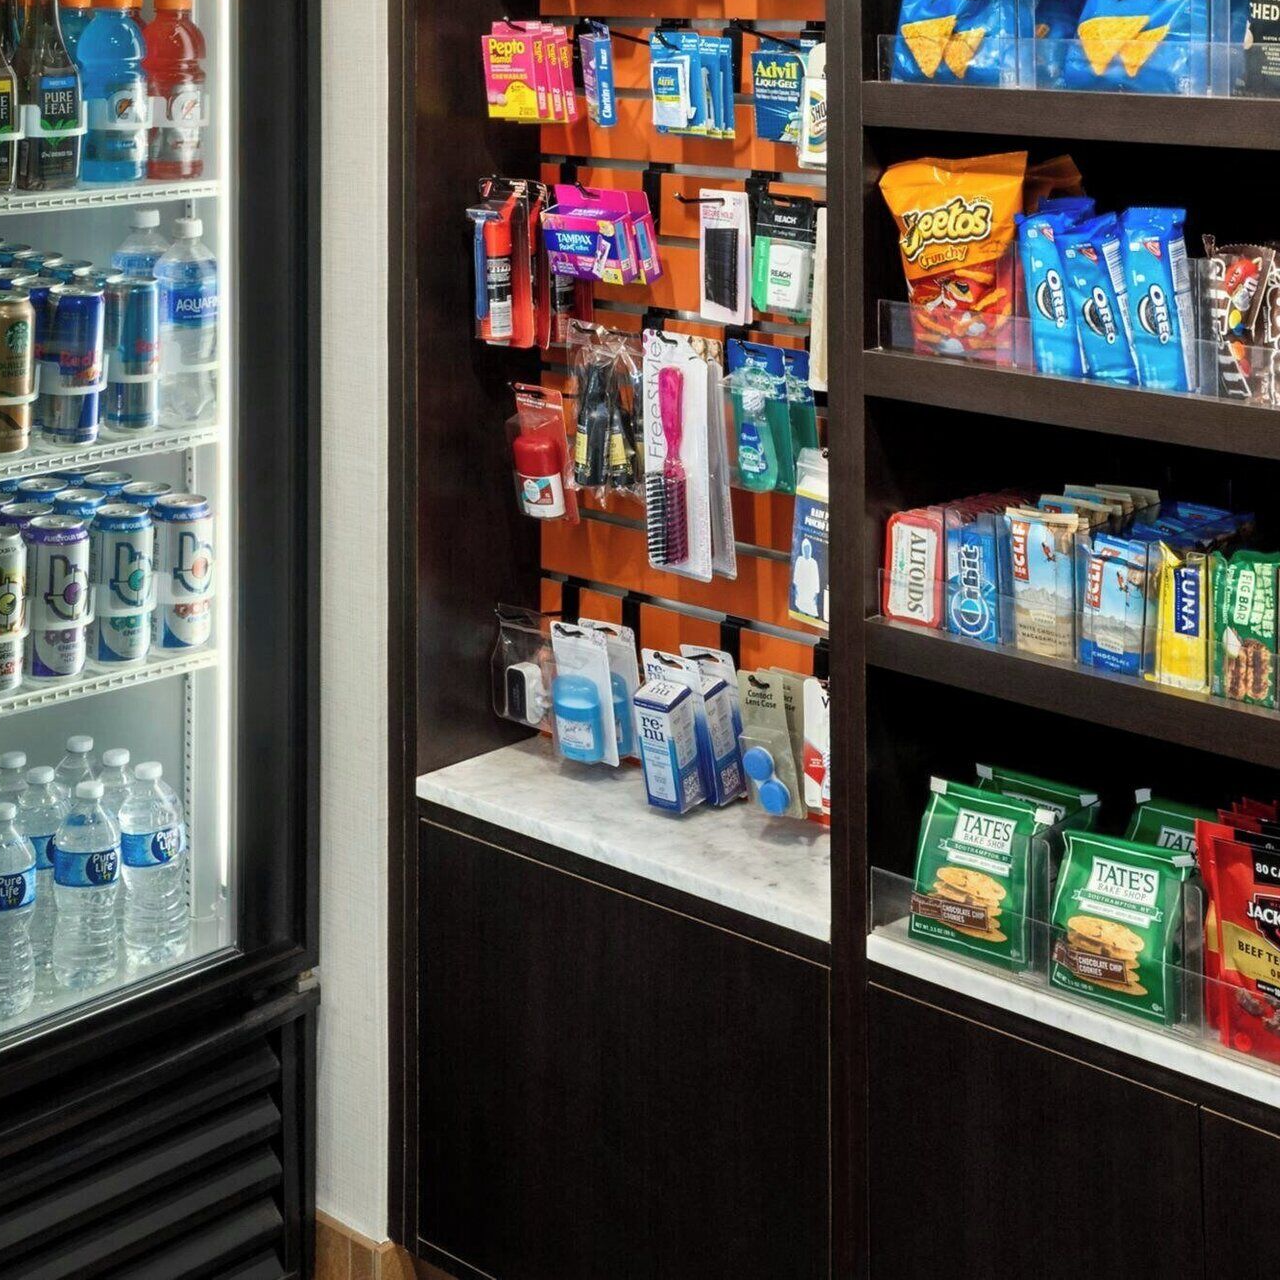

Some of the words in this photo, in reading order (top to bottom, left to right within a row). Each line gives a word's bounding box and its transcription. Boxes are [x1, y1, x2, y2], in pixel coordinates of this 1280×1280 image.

[489, 39, 525, 54] Pepto
[755, 61, 799, 79] Advil
[44, 91, 74, 103] PURE
[44, 102, 74, 115] LEAF
[774, 214, 797, 225] REACH
[555, 232, 592, 246] TAMPAX
[919, 245, 969, 270] Crunchy
[770, 269, 791, 279] REACH
[1046, 269, 1067, 329] OREO
[1091, 286, 1116, 345] OREO
[1149, 284, 1170, 345] OREO
[907, 531, 927, 614] ALTOIDS
[1243, 571, 1254, 597] FIG
[1179, 568, 1197, 632] LUNA
[1234, 600, 1246, 623] BAR
[747, 689, 774, 701] Contact
[745, 698, 760, 706] Lens
[761, 699, 776, 710] Case
[963, 812, 1012, 842] TATE'S
[963, 835, 984, 846] BAKE
[986, 839, 1005, 849] SHOP
[1255, 862, 1269, 875] 80
[1096, 861, 1155, 893] TATE'S
[1097, 883, 1121, 894] BAKE
[971, 910, 985, 920] CHIP
[1238, 940, 1264, 959] BEEF
[1078, 955, 1108, 970] CHOCOLATE
[1078, 964, 1103, 976] COOKIES
